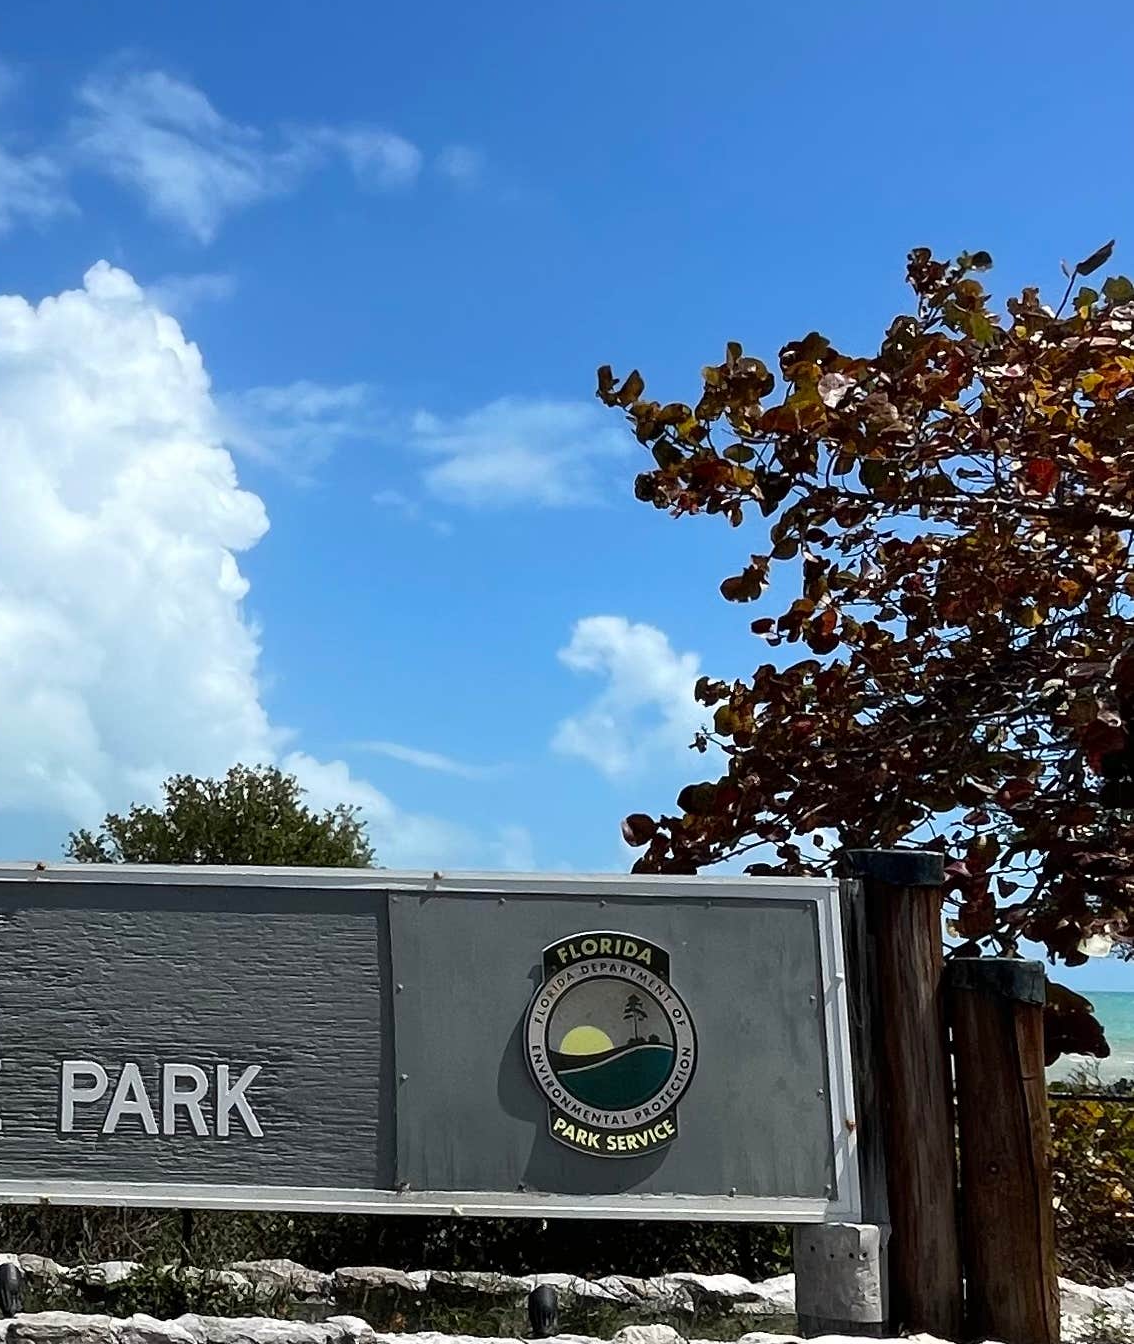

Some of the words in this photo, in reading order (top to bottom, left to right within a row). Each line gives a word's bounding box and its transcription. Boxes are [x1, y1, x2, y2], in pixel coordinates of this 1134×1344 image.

[557, 938, 652, 965] FLORIDA
[534, 971, 574, 1024] FLORIDA
[580, 962, 673, 1002] DEPARTMENT
[672, 1008, 686, 1026] OF
[60, 1060, 264, 1137] PARK
[532, 1044, 628, 1125] ENVIRONMENTAL
[634, 1047, 691, 1121] PROTECTION
[553, 1117, 600, 1149] PARK
[606, 1120, 676, 1152] SERVICE
